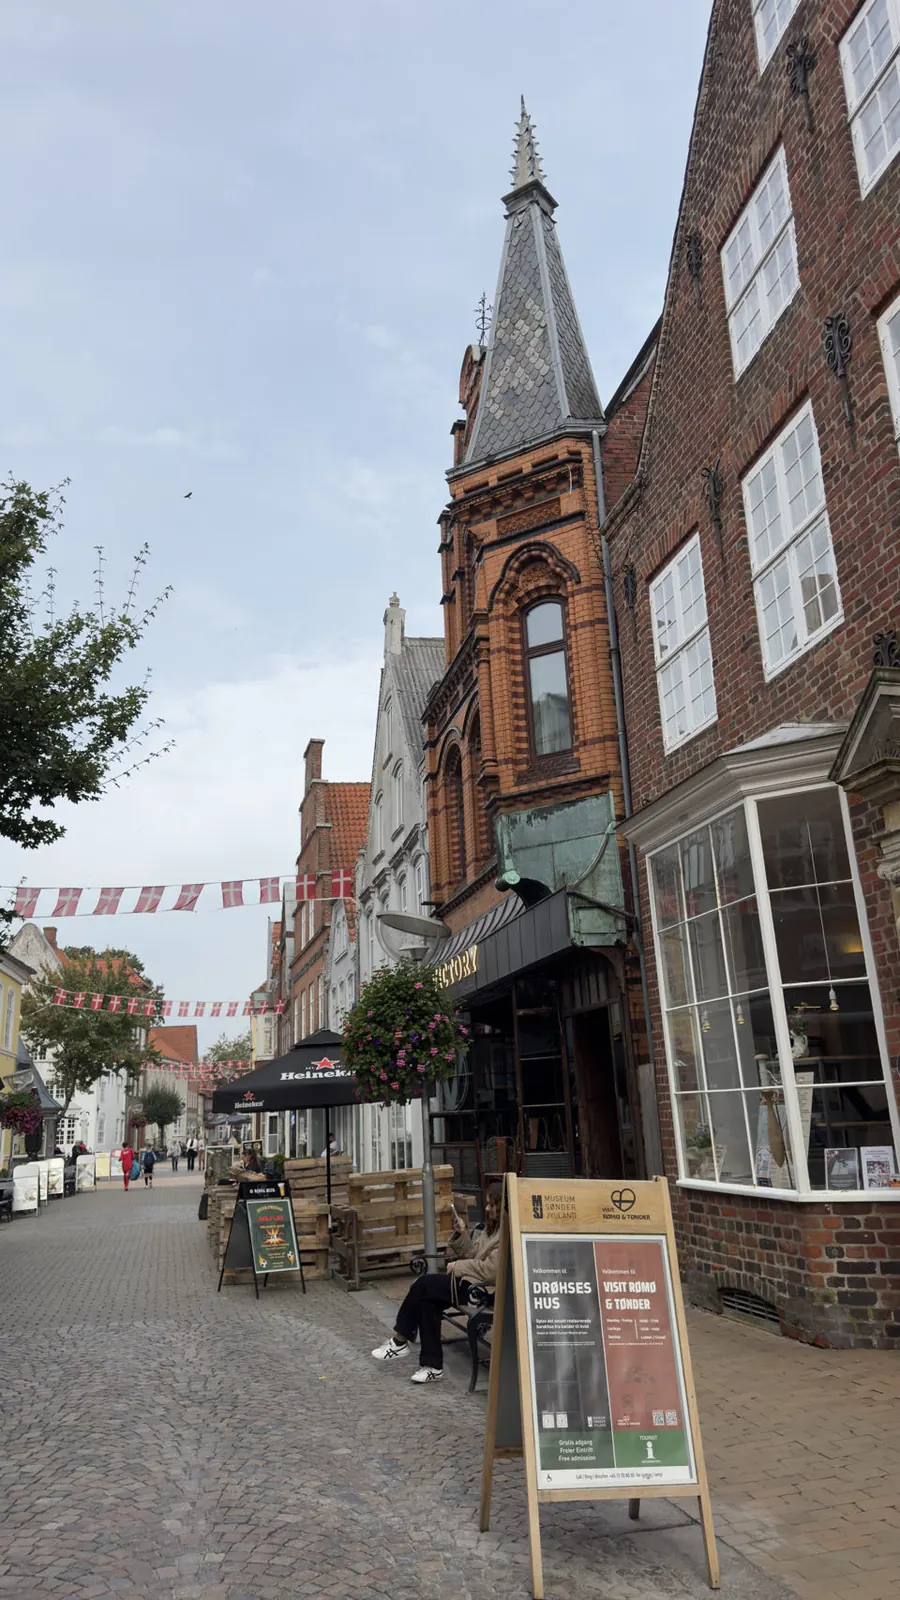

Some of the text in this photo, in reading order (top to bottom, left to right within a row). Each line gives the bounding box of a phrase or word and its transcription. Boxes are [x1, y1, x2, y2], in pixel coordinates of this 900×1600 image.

[280, 1069, 356, 1081] Heinek
[234, 1100, 263, 1109] Heineken
[544, 1203, 576, 1211] SØNDER
[532, 1281, 592, 1294] DRØHSES
[603, 1280, 656, 1293] VISIT RØMØ
[534, 1297, 560, 1310] HUS
[605, 1298, 651, 1310] & TØNDER
